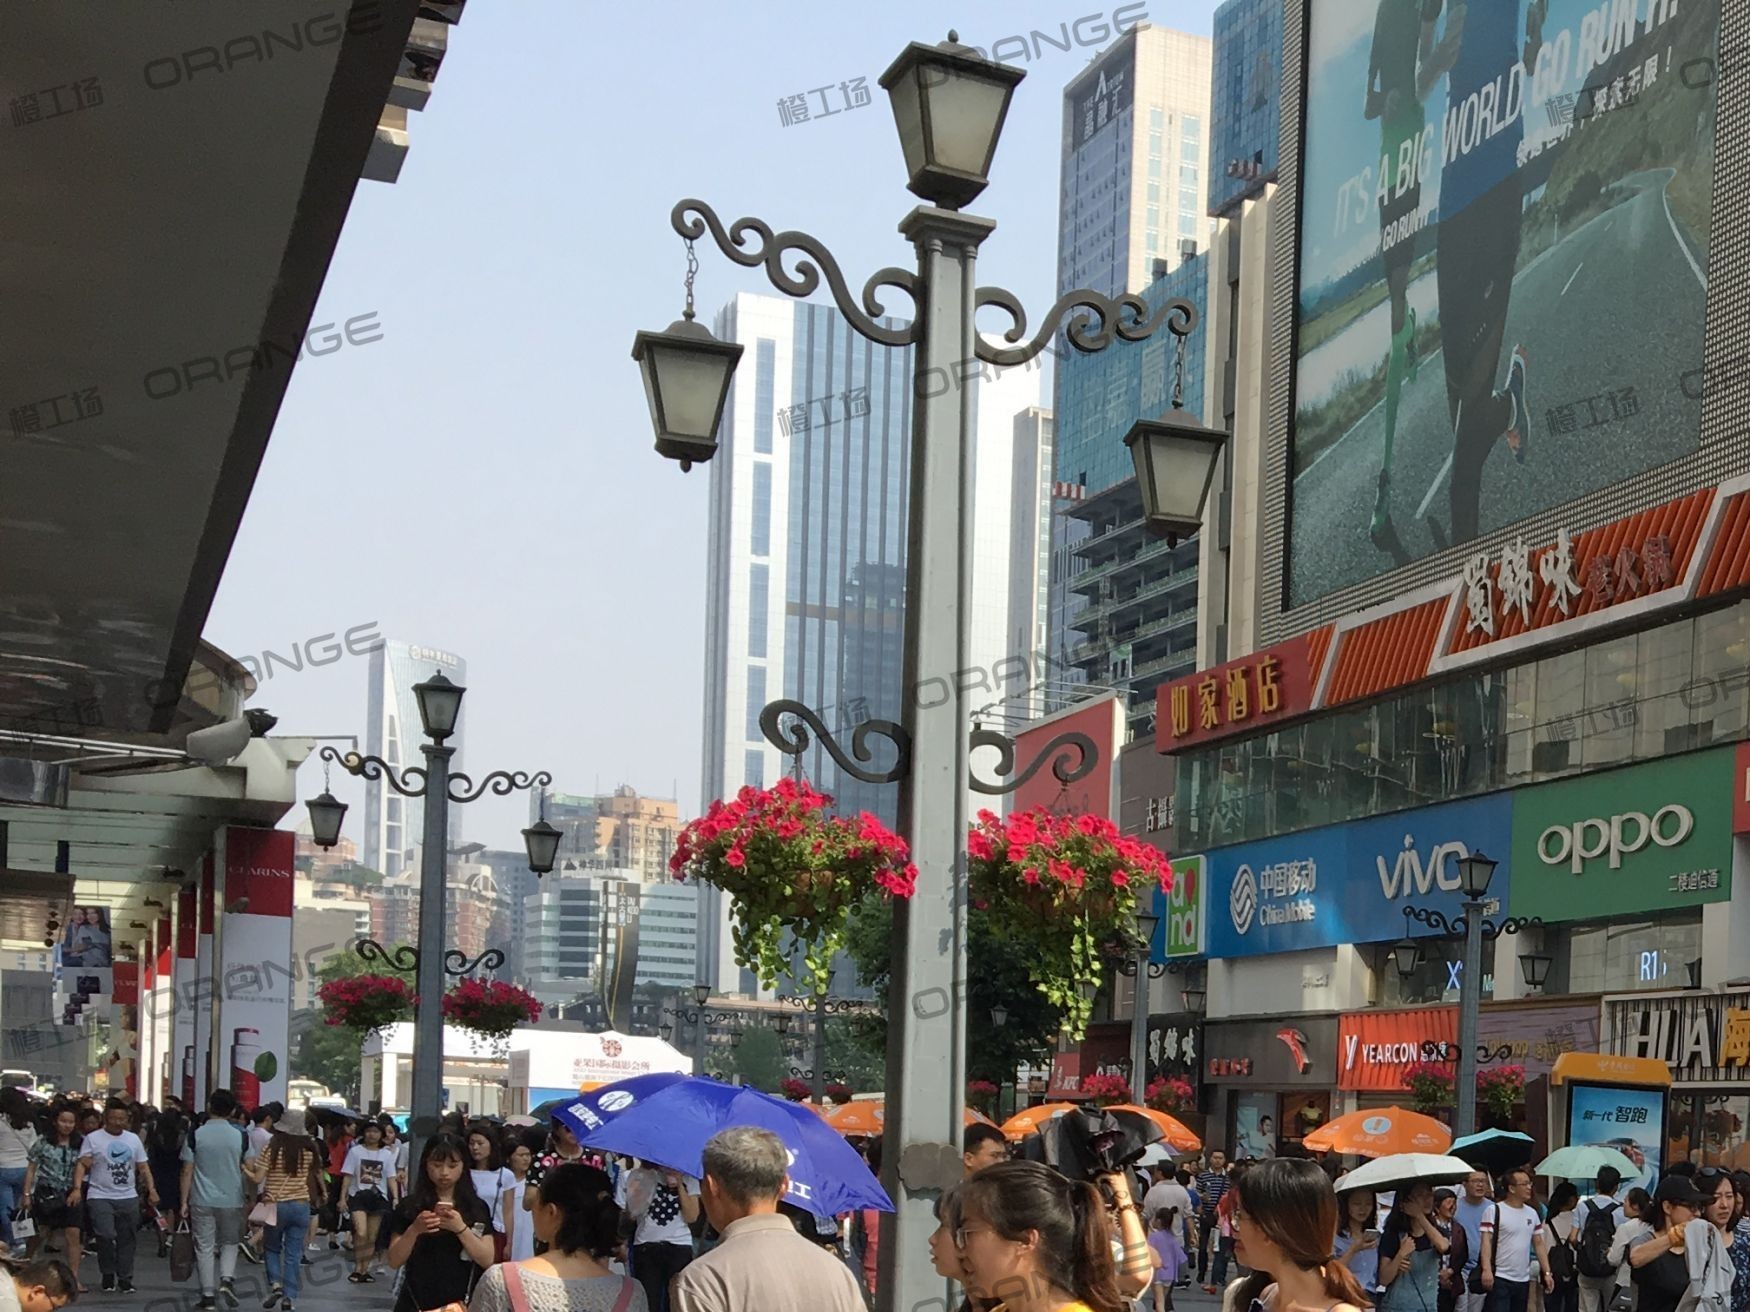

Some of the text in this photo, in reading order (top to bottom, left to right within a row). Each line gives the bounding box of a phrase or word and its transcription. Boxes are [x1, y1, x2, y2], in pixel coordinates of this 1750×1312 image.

[1395, 122, 1434, 200] BIG
[1441, 60, 1526, 169] WORLD
[1532, 29, 1570, 107] GO
[1170, 655, 1280, 737] 如家酒店
[1259, 861, 1317, 900] 中国移动
[1361, 1041, 1418, 1063] YEARCON
[1615, 1105, 1649, 1125] 智跑
